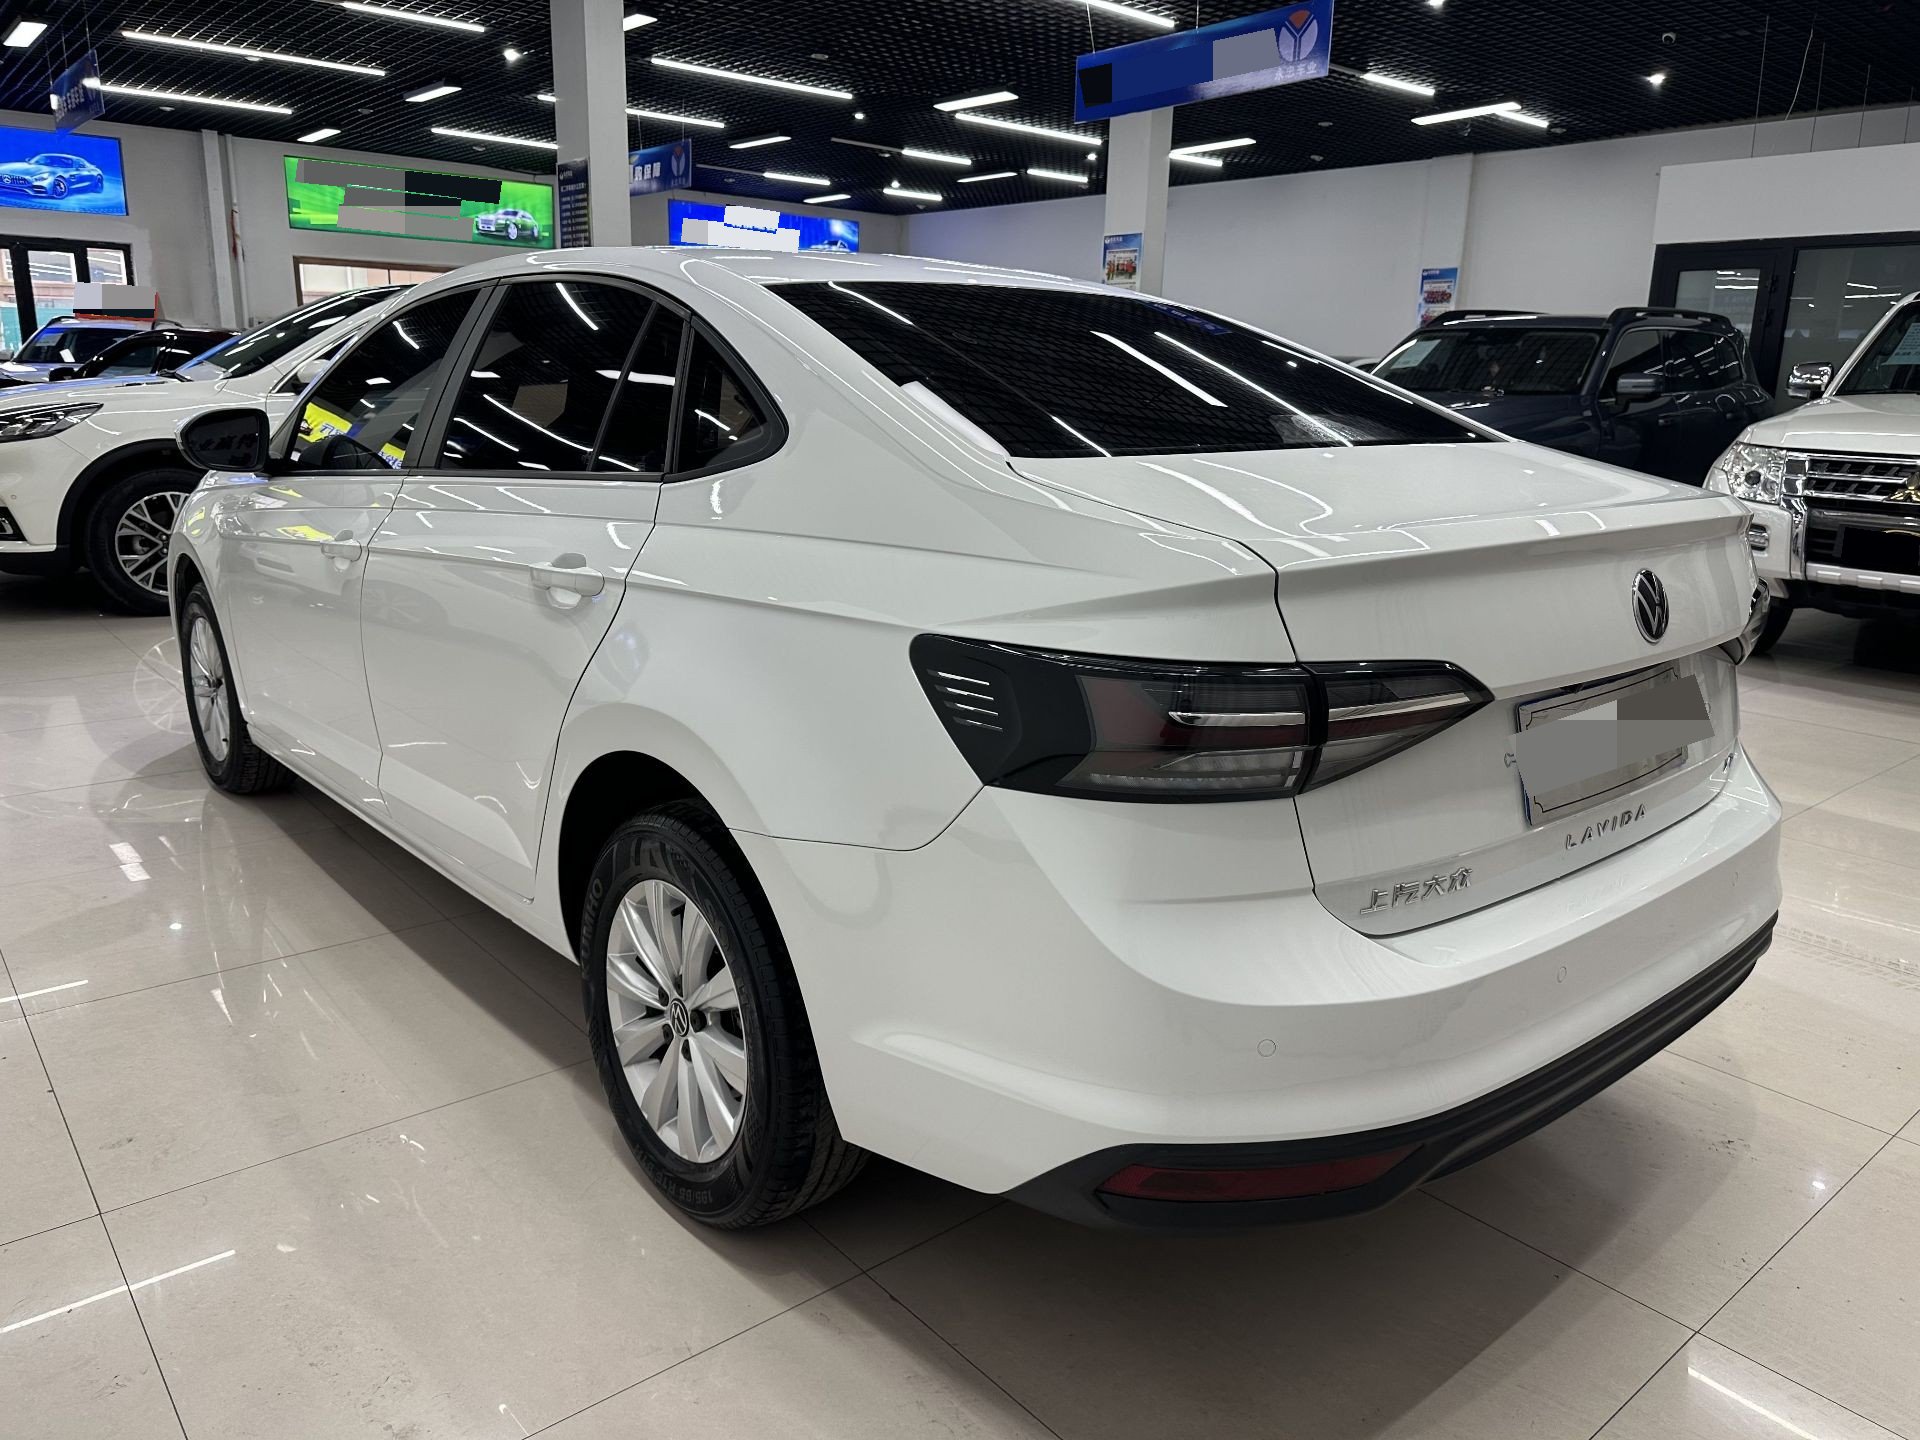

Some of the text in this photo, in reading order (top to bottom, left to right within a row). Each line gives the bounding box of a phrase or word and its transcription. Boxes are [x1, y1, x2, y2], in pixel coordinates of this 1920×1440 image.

[629, 162, 661, 183] 购保障
[1565, 803, 1647, 850] LAVIDA
[1359, 866, 1474, 915] 上汽大众
[581, 878, 603, 980] KUMHO
